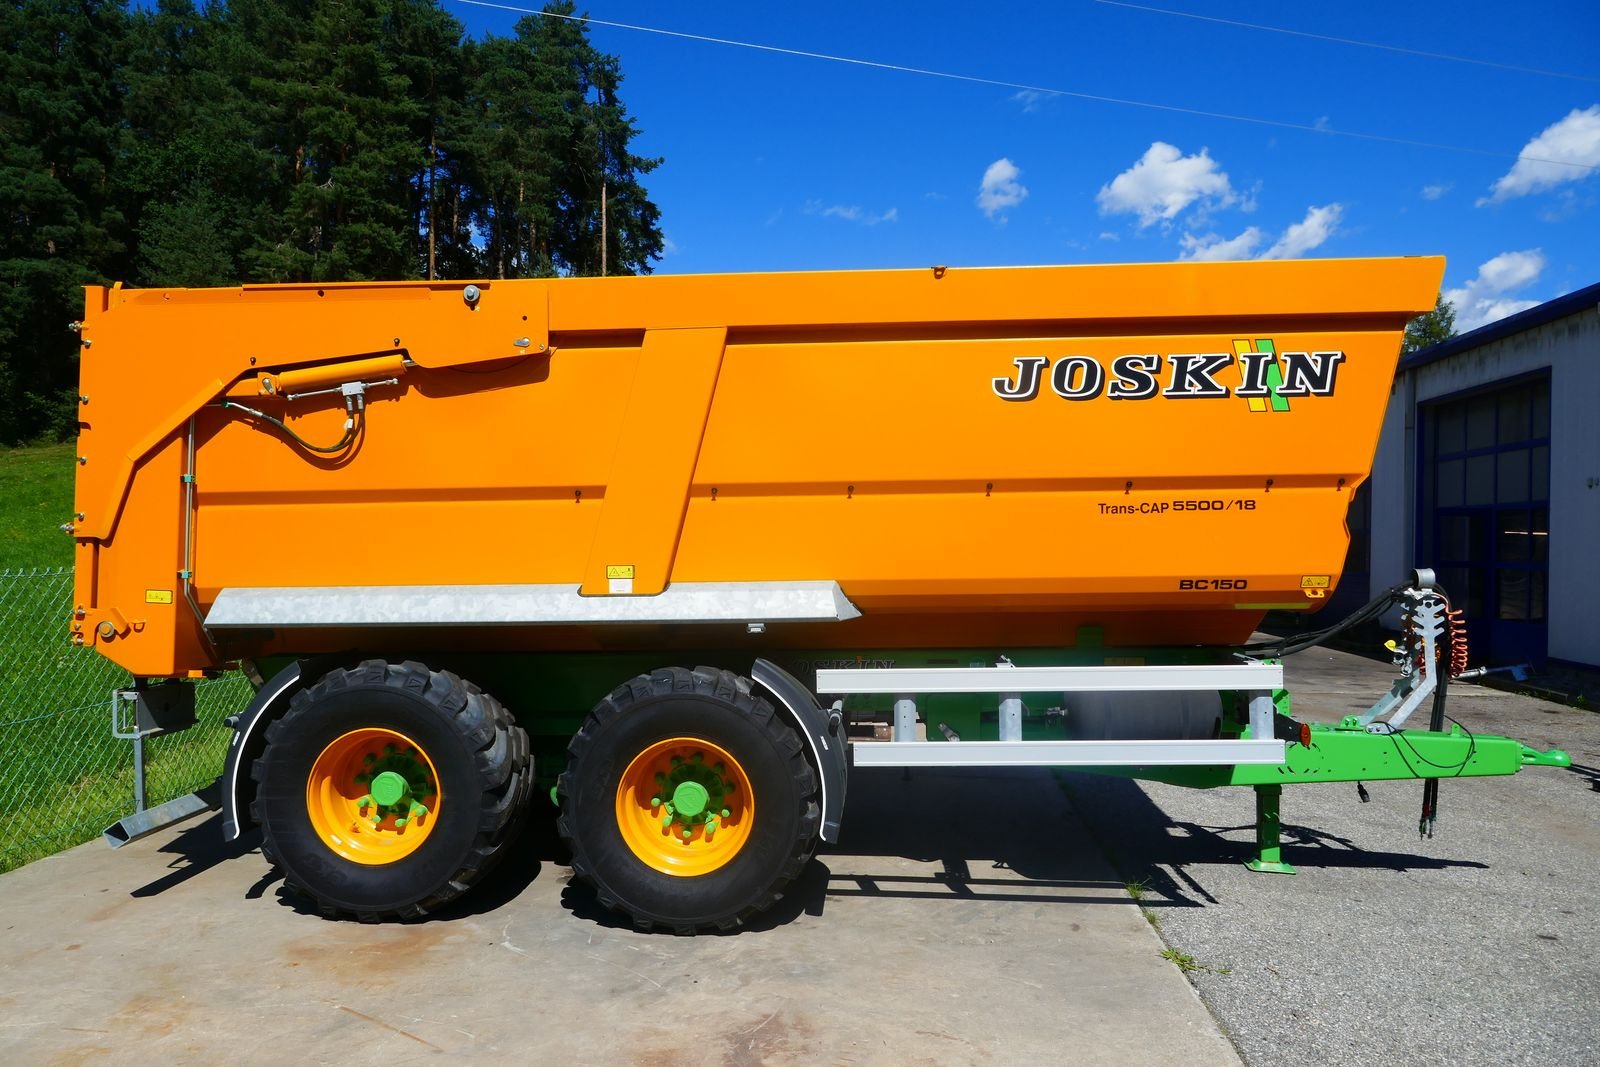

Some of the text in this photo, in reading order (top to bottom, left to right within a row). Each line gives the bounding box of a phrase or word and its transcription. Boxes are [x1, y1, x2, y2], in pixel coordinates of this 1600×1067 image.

[992, 351, 1346, 400] JOSKIN
[1098, 500, 1257, 514] Trans-CAP 5500/18
